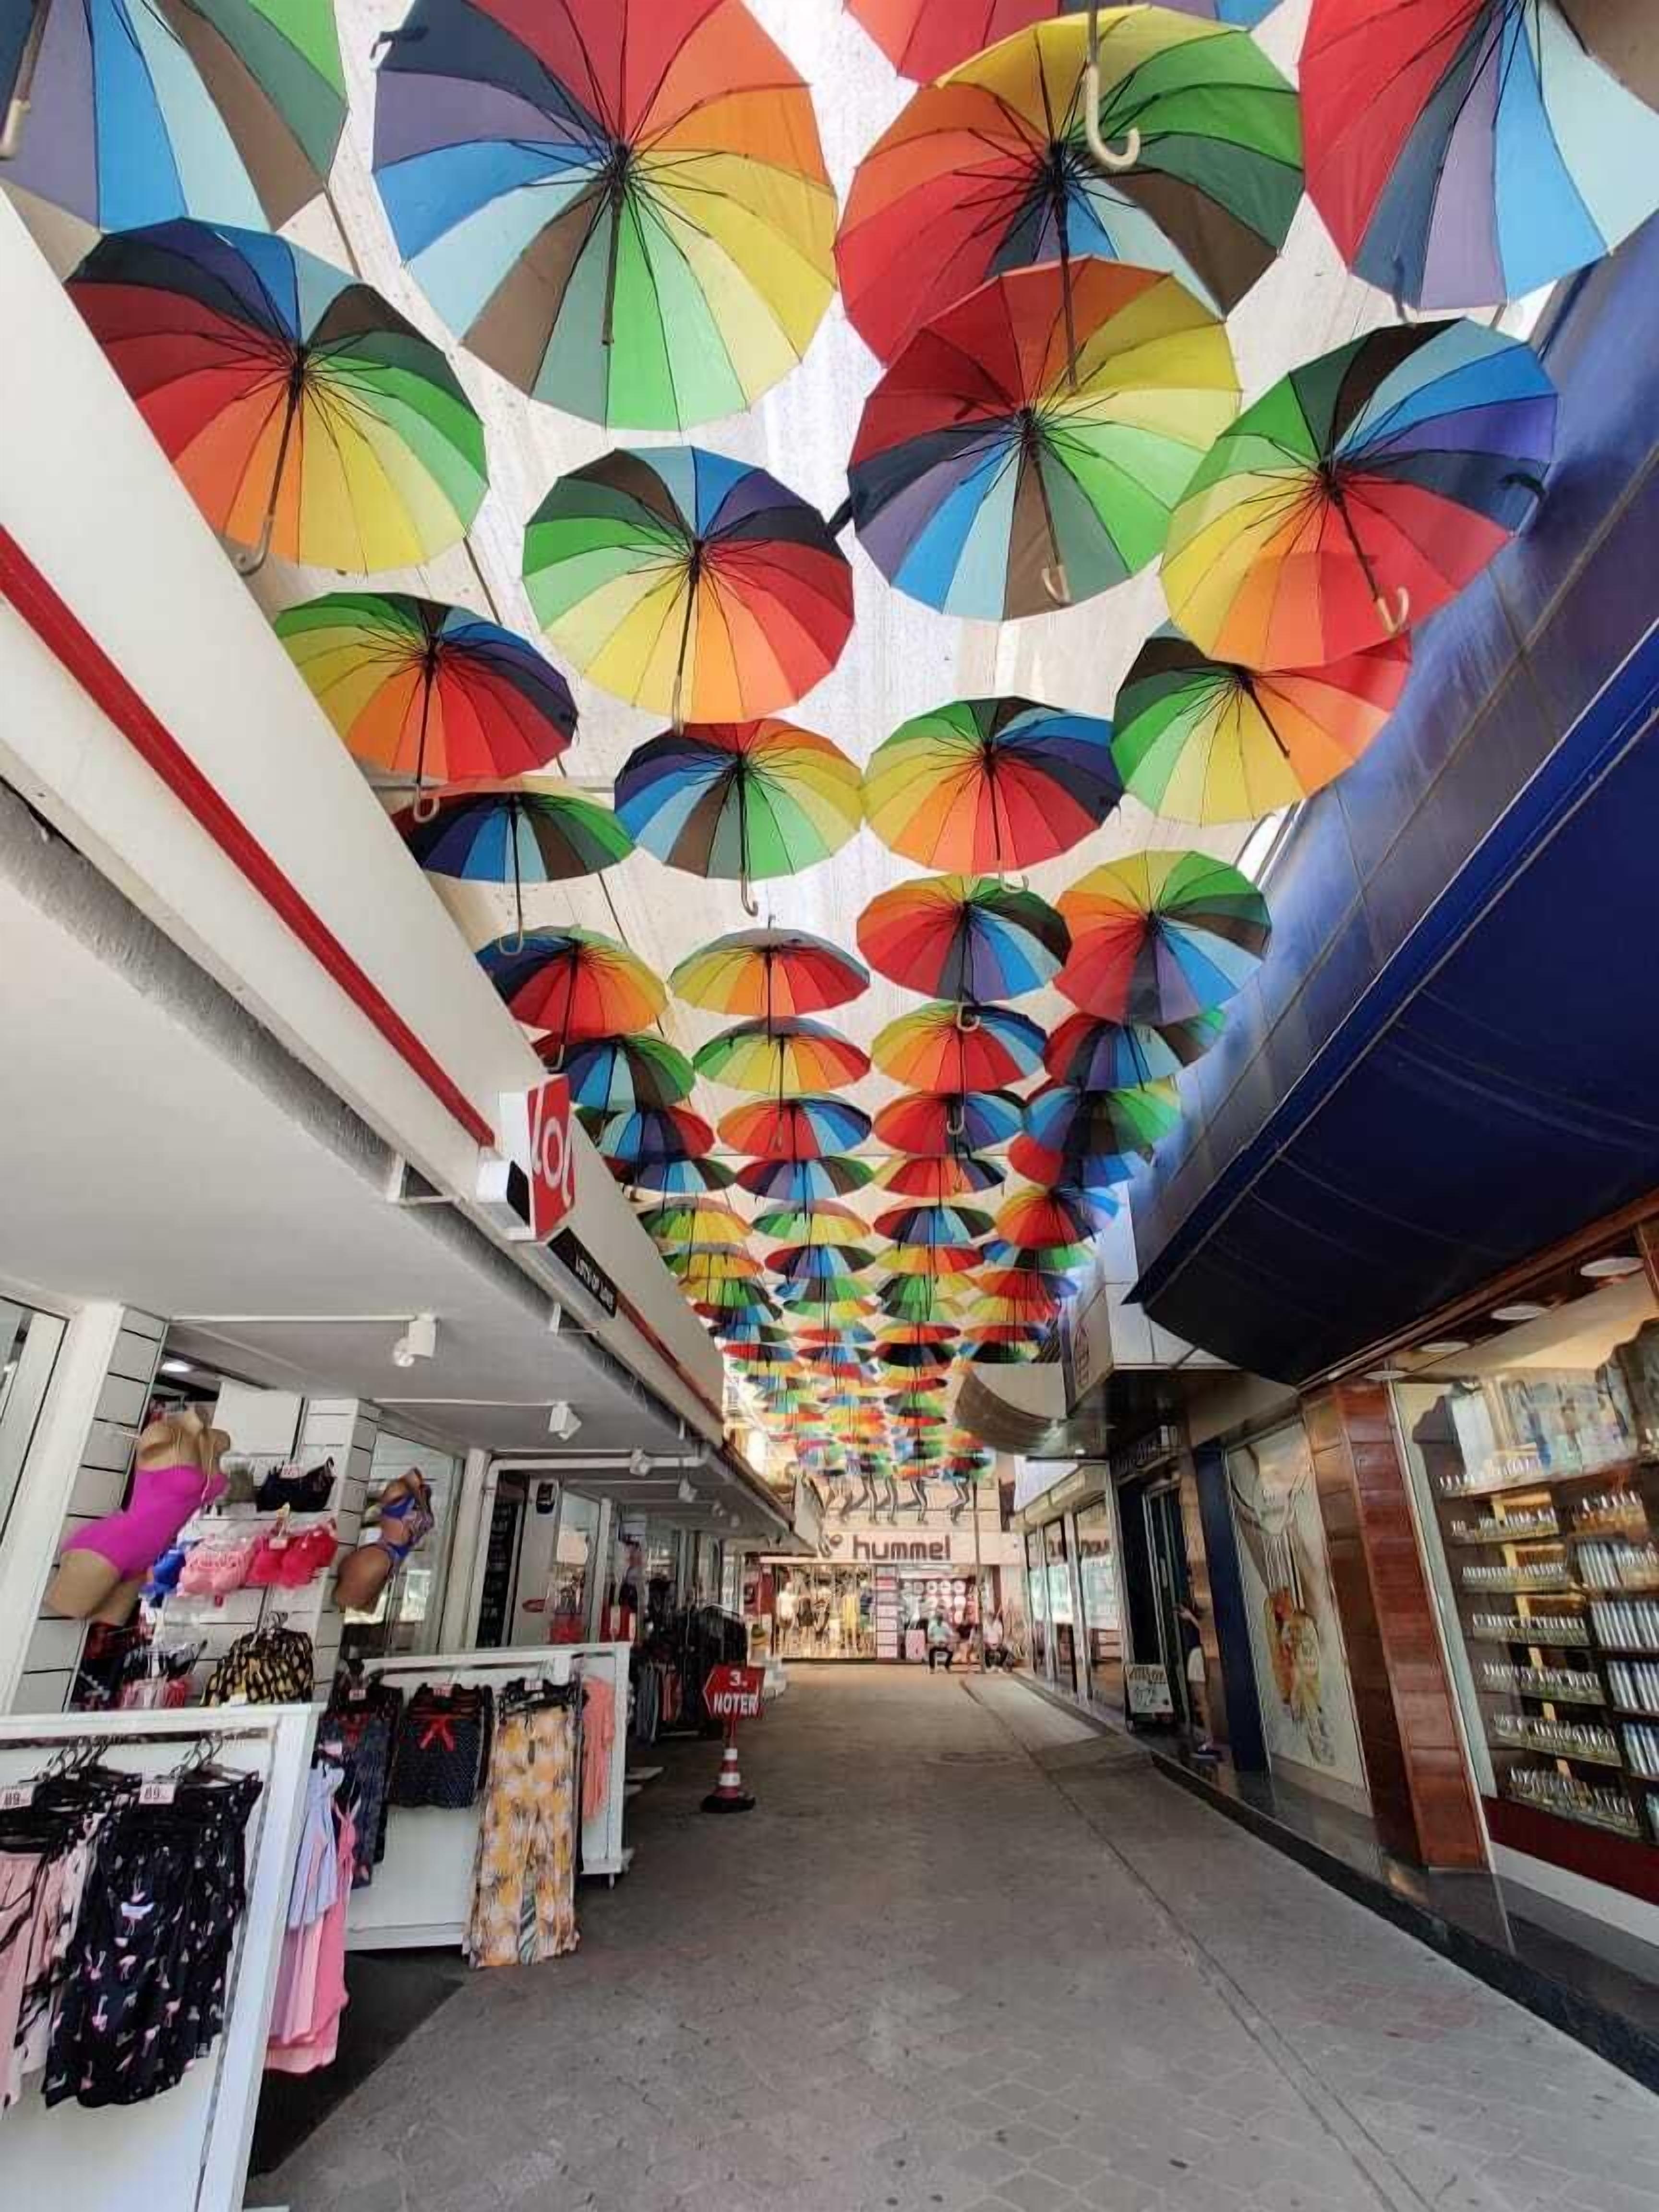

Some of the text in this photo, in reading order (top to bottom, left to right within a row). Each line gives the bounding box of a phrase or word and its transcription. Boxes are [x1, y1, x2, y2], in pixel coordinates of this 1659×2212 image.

[853, 1535, 951, 1560] hummel
[729, 1670, 748, 1686] 3.
[713, 1693, 758, 1715] NOTER
